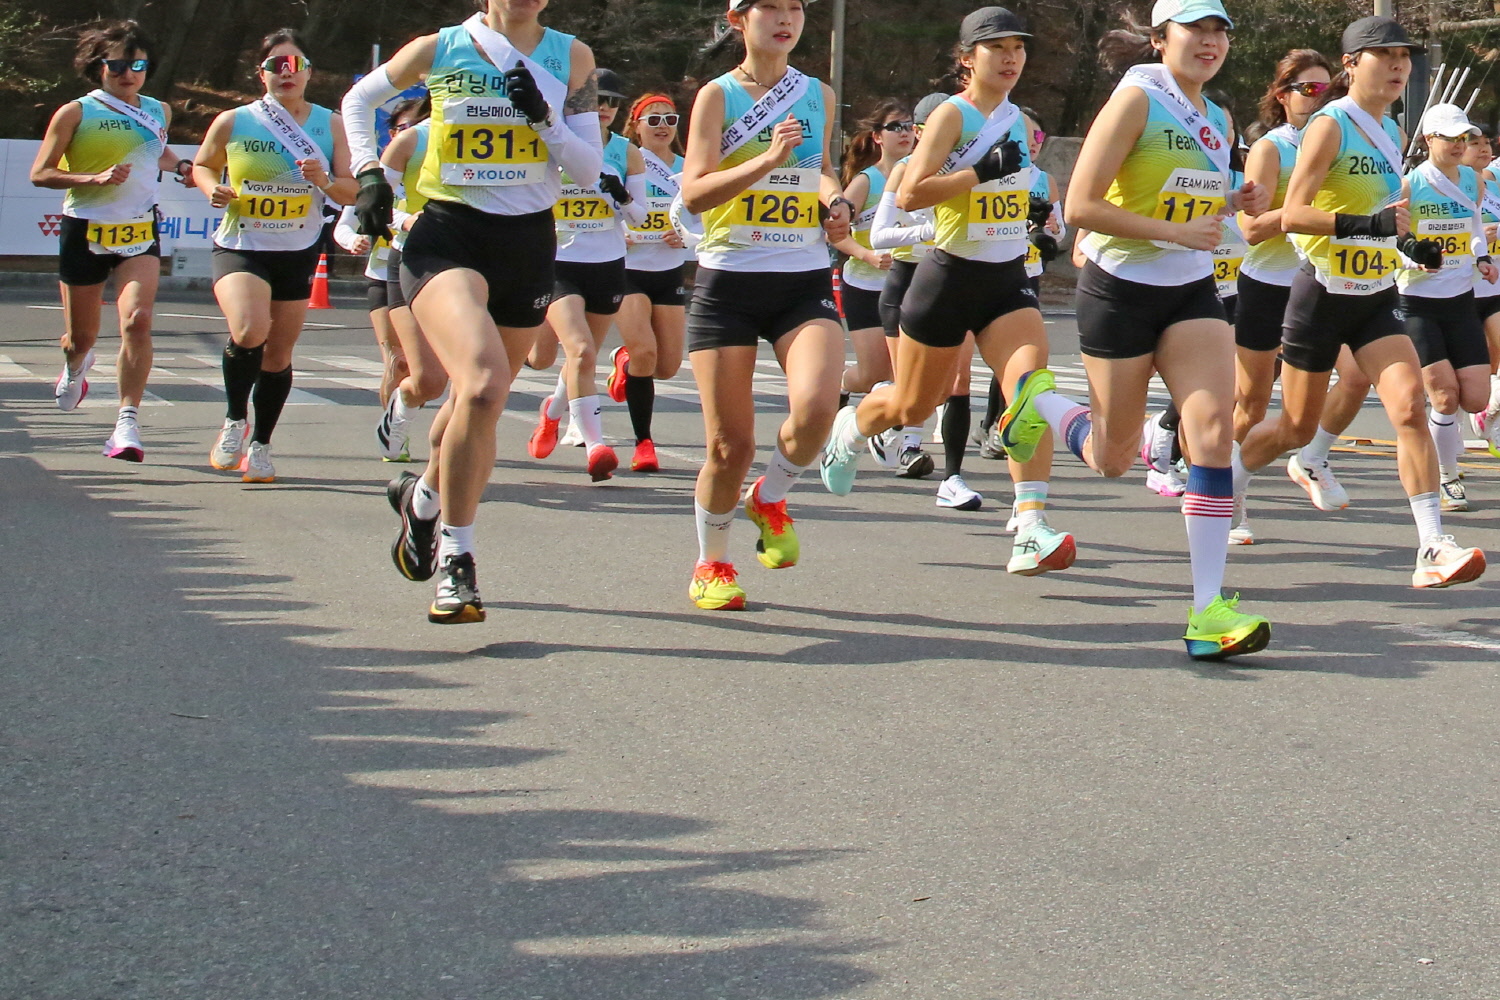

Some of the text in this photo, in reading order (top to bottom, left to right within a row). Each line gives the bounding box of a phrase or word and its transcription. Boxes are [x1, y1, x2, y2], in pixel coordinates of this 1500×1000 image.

[444, 73, 510, 95] 런닝메
[466, 105, 527, 119] 런닝메이트
[99, 119, 132, 131] 서라벌
[758, 118, 813, 143] 빤런
[243, 140, 290, 155] VGVR_H
[450, 128, 539, 159] 131-1
[1349, 155, 1396, 175] 262wa
[477, 169, 527, 180] KOLON
[769, 174, 800, 186] 빤스런
[247, 183, 310, 195] VGVR_Hanam
[580, 188, 597, 196] Fun
[650, 184, 671, 196] Tea
[1175, 176, 1222, 191] TEAM WRC
[247, 197, 305, 217] 101-1
[559, 200, 609, 218] 137-1
[741, 194, 814, 224] 126-1
[976, 194, 1028, 220] 105-1
[1163, 196, 1215, 223] 117
[262, 221, 294, 230] KOLON
[640, 213, 670, 230] 35-
[93, 225, 147, 245] 113-1
[763, 232, 804, 243] KOLON
[1335, 249, 1397, 276] 104-1
